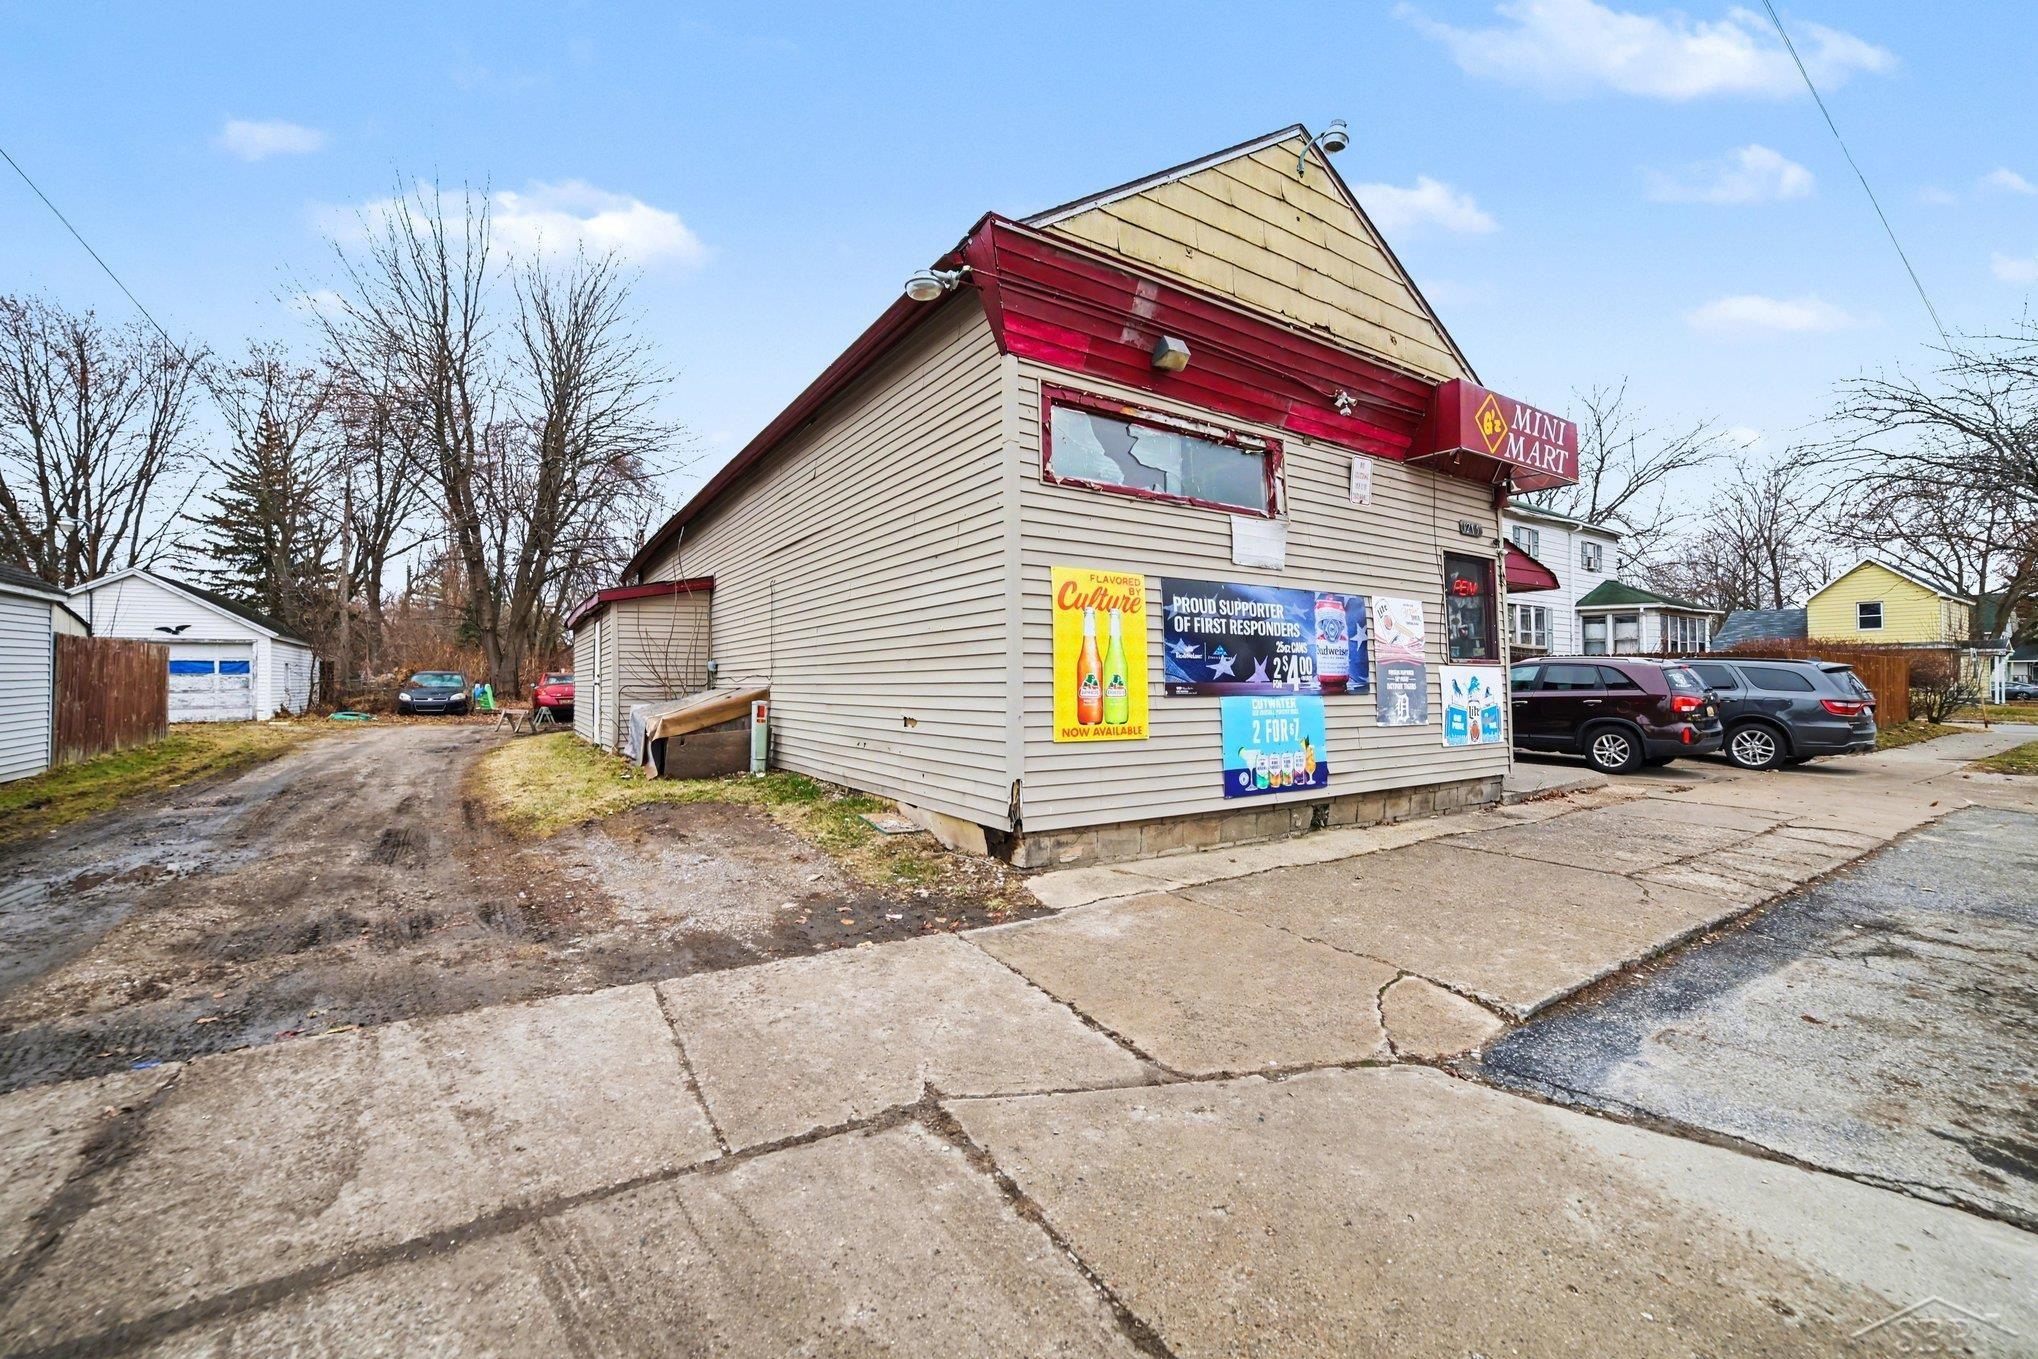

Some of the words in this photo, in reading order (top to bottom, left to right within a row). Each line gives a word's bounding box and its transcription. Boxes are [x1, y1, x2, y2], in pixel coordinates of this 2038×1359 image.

[1511, 404, 1566, 446] MINI
[1504, 432, 1568, 474] MART
[1090, 574, 1141, 587] FLAVORED
[1058, 581, 1142, 614] Culture
[1129, 588, 1142, 596] BY
[1173, 596, 1217, 614] PROUD
[1219, 599, 1285, 619] SUPPORTER
[1174, 616, 1190, 633] OF
[1194, 617, 1228, 635] FIRST
[1230, 619, 1300, 638] RESPONDERS
[1273, 657, 1281, 679] 2
[1252, 698, 1297, 710] CUTWATER
[1468, 705, 1480, 719] Lite
[1062, 726, 1090, 738] NOW
[1093, 725, 1143, 736] AVAILABLE
[1252, 721, 1261, 744] 2
[1265, 719, 1288, 744] FOR
